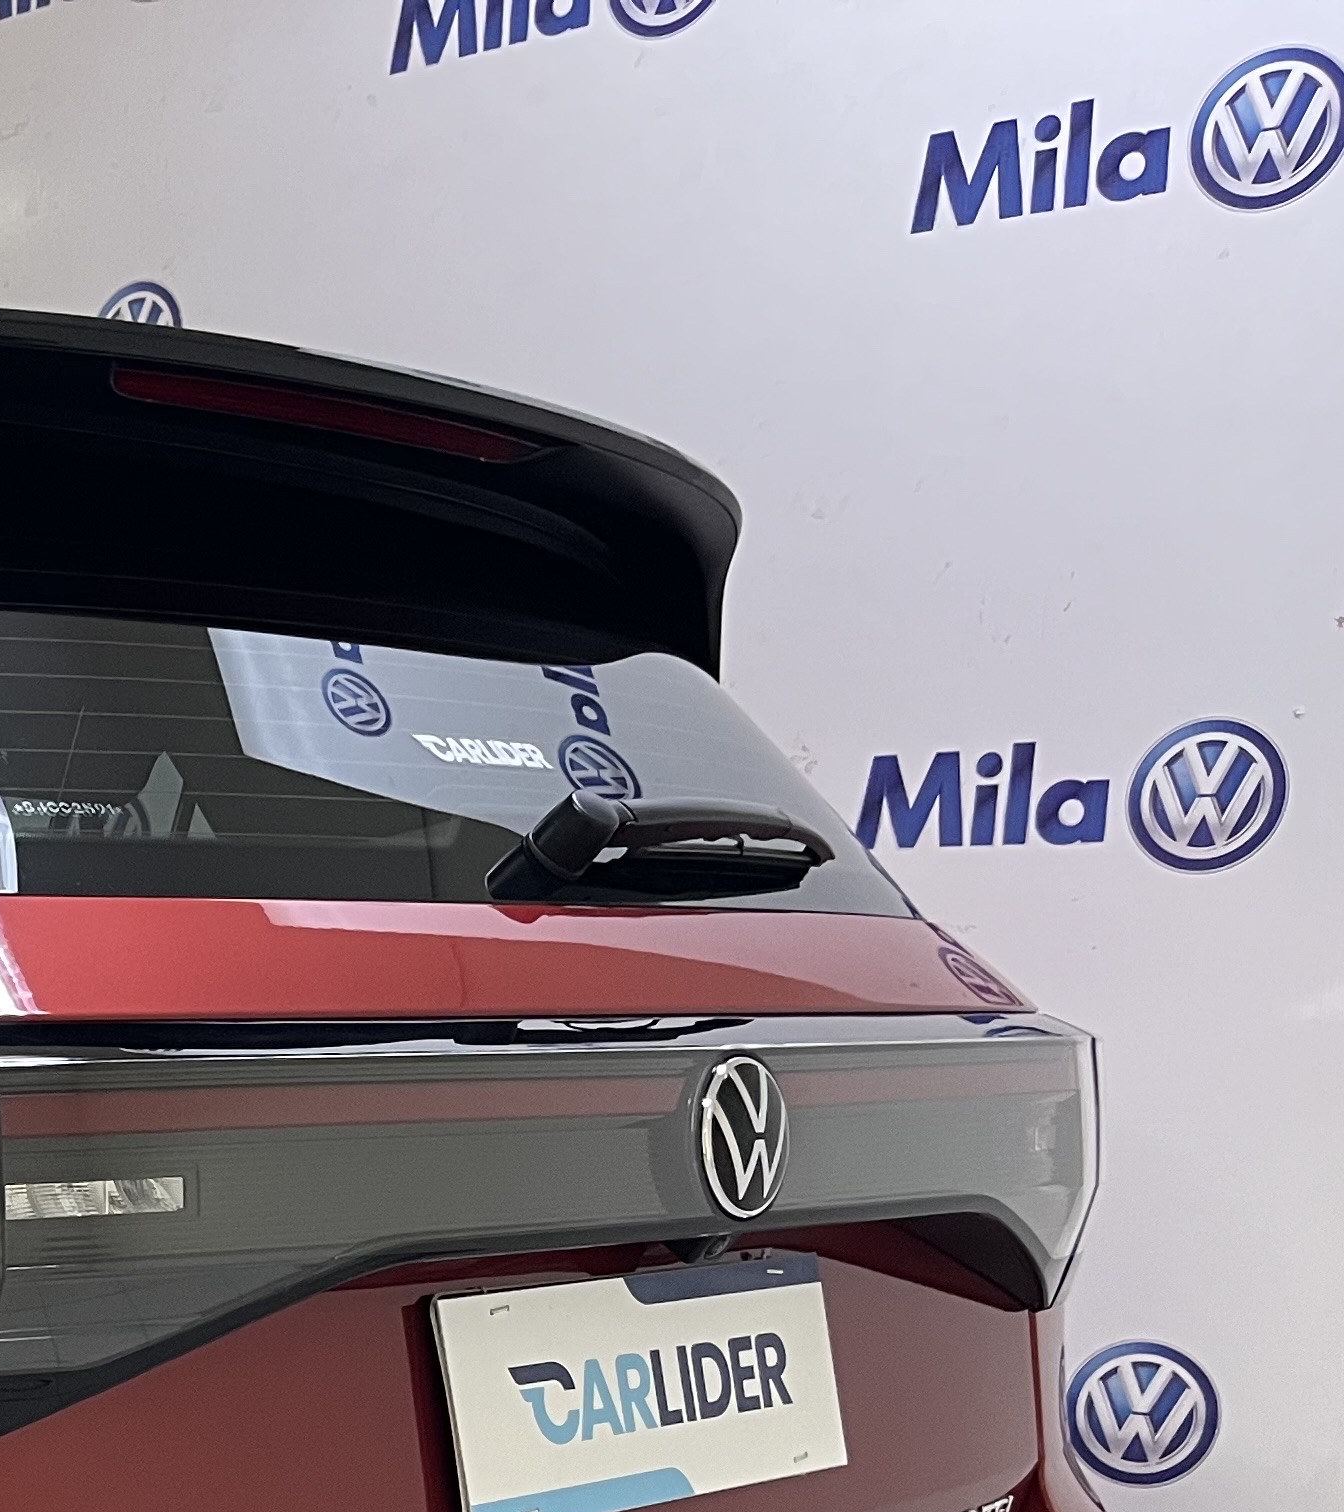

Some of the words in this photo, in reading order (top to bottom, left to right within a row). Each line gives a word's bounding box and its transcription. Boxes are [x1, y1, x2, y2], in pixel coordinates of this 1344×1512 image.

[390, 0, 590, 75] Mila
[911, 99, 1171, 234] Mila
[411, 733, 554, 770] CARLIDER
[855, 742, 1110, 850] Mila
[508, 1332, 794, 1446] CARLIDER
